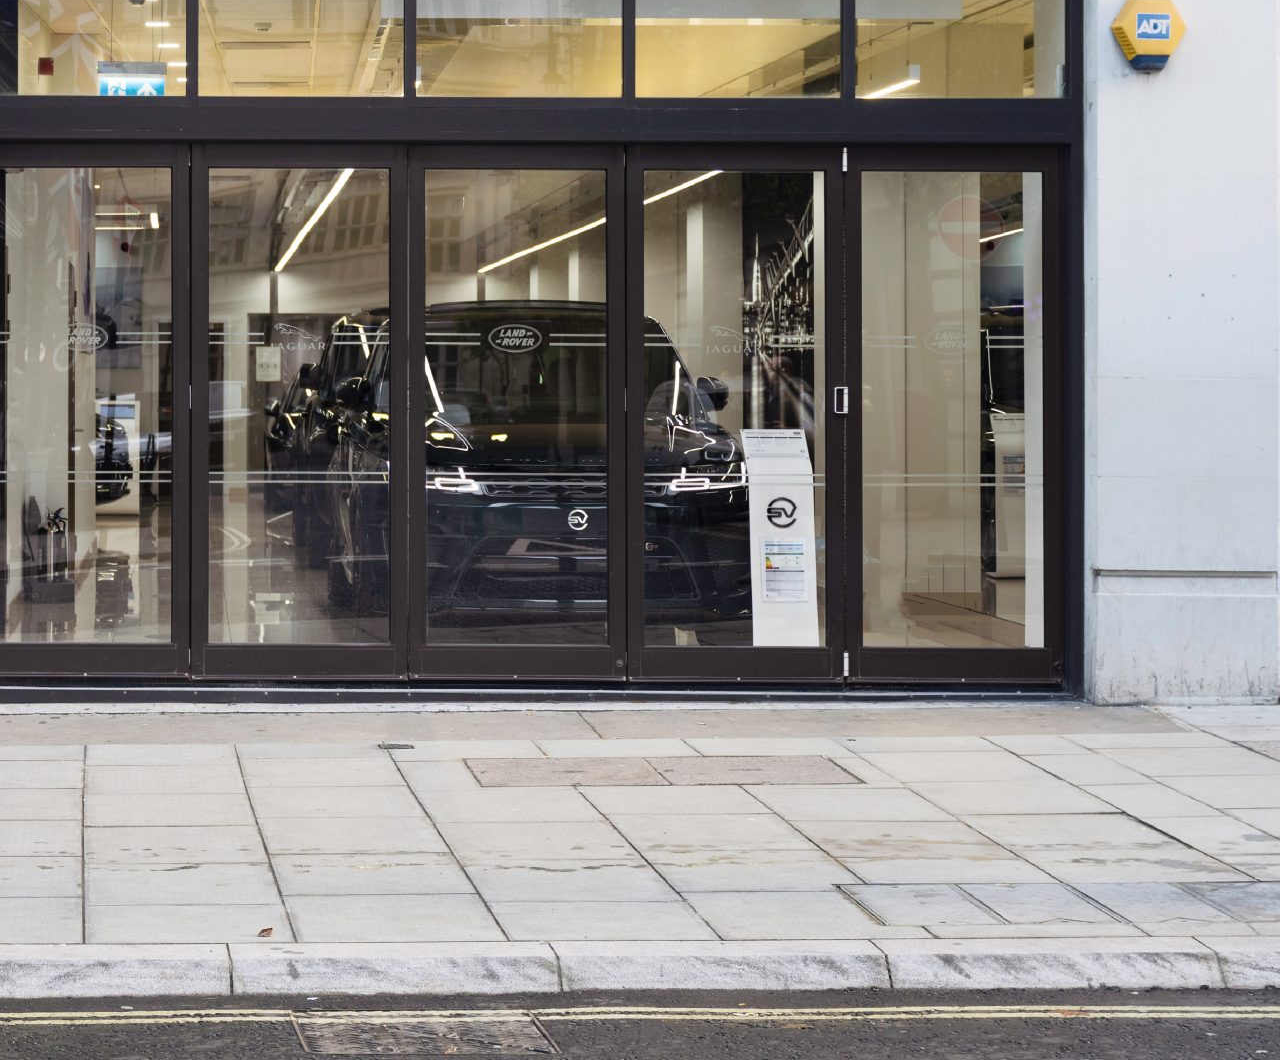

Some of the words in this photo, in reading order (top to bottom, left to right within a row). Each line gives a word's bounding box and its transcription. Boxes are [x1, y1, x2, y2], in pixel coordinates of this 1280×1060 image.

[1136, 18, 1170, 35] ADT
[500, 329, 526, 337] LAND
[68, 336, 101, 344] ROVER
[501, 338, 535, 346] ROVER
[270, 341, 326, 351] JAGUAR
[705, 344, 761, 355] JAGUAR
